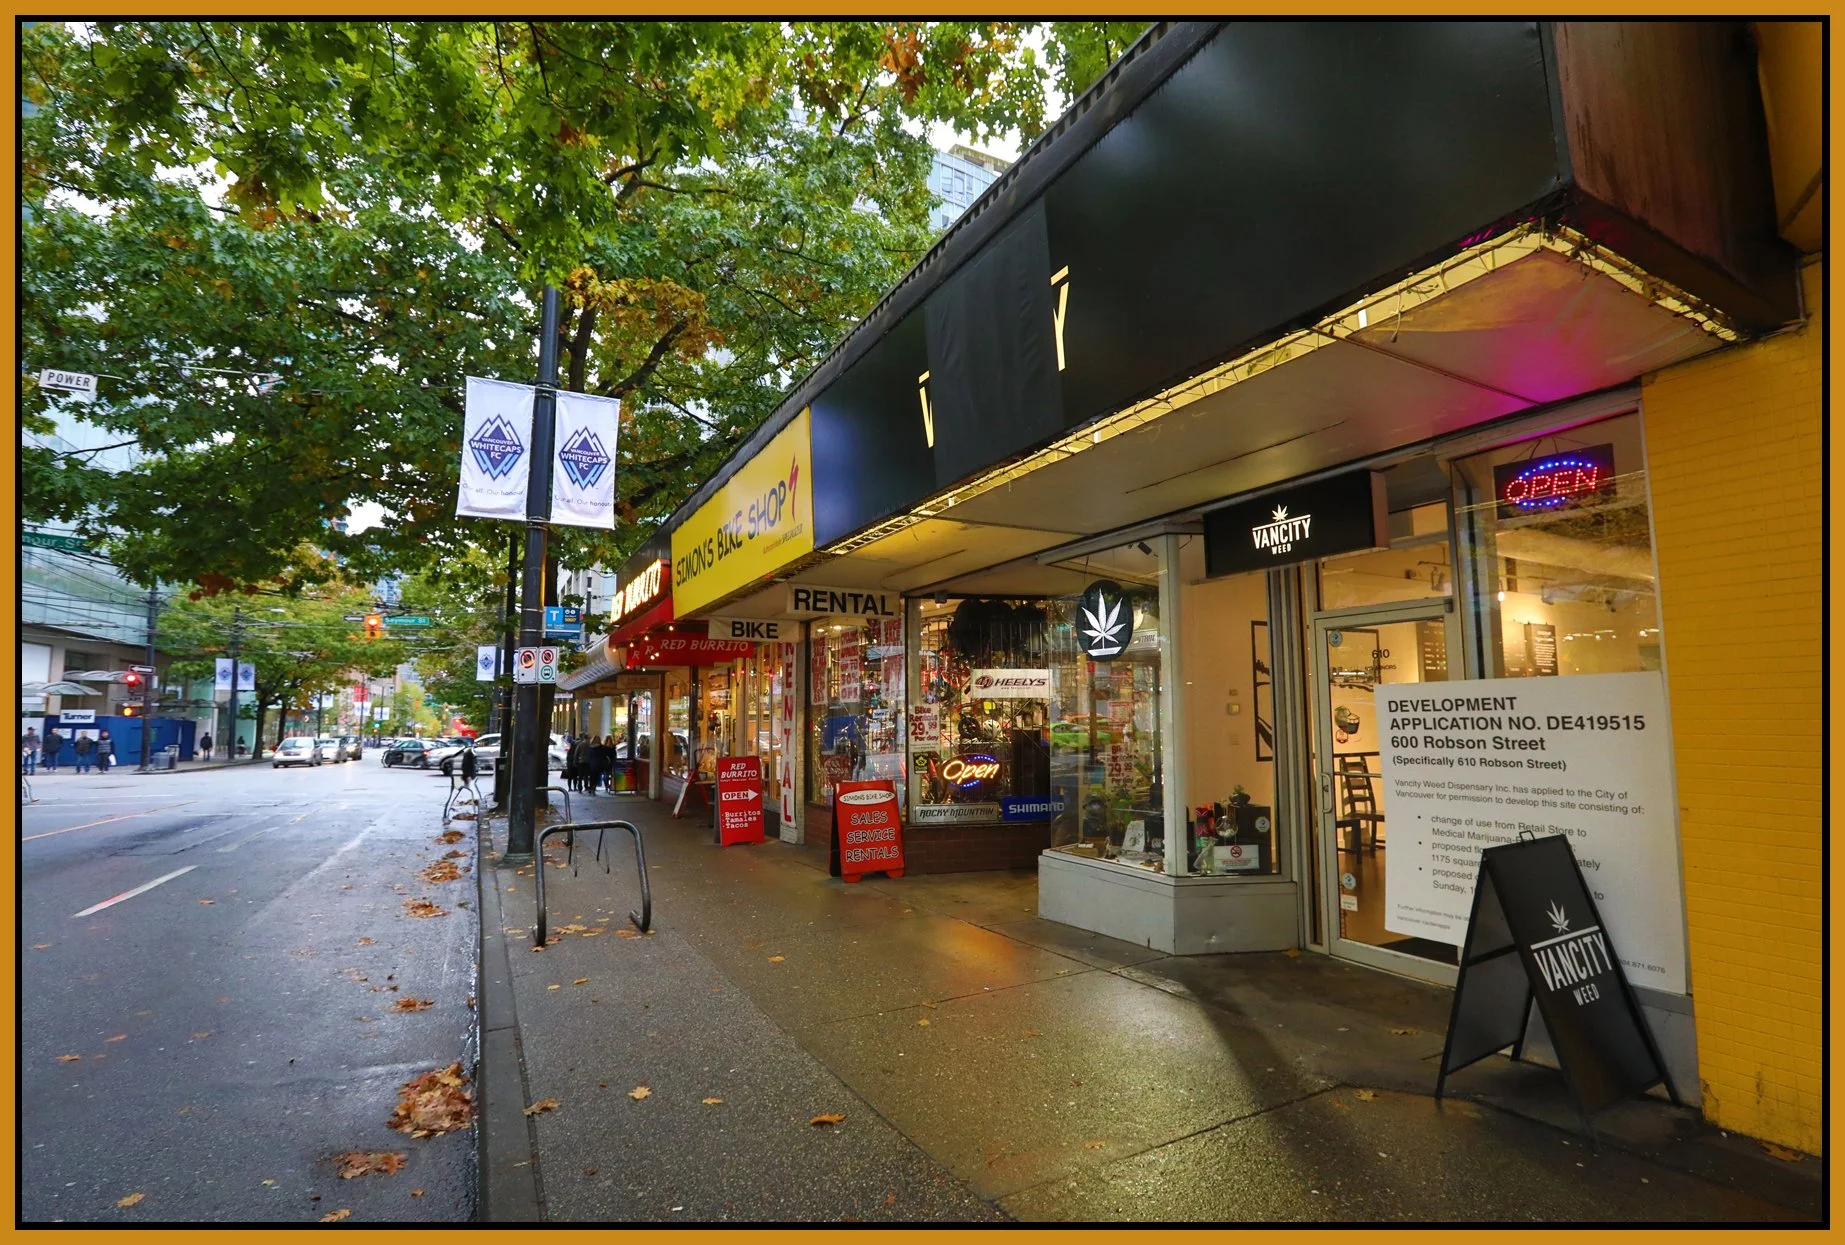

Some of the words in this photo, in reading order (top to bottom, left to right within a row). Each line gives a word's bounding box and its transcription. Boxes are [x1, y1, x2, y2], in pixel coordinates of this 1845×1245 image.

[48, 372, 90, 387] POWER
[471, 440, 521, 453] WHITECAPS
[482, 437, 514, 445] VANCOUVER
[490, 452, 501, 460] FC
[561, 452, 608, 464] WHITECAPS
[578, 462, 589, 470] FC
[1507, 467, 1598, 501] OPEN
[676, 537, 714, 587] SIMON'S
[717, 510, 743, 561] BIKE
[748, 480, 786, 540] SHOP
[1252, 518, 1311, 549] VANCITY
[1272, 543, 1292, 555] WEED
[794, 588, 894, 616] RENTAL
[384, 617, 416, 625] Seymour
[731, 621, 779, 639] BIKE
[660, 639, 686, 650] RED
[690, 639, 748, 652] BURRITO
[1372, 649, 1390, 659] 610
[994, 678, 1048, 686] HEELYS
[915, 706, 931, 714] Bike
[1388, 696, 1517, 713] DEVELOPMENT
[62, 712, 92, 720] Turner
[1390, 717, 1501, 731] APPLICATION
[1508, 717, 1541, 731] NO.
[1547, 715, 1645, 731] DE419515
[1391, 736, 1419, 749] 600
[1424, 736, 1487, 750] Robson
[1493, 736, 1546, 751] Street
[730, 763, 747, 771] RED
[1392, 755, 1454, 768] (Specifically
[1457, 756, 1477, 767] 610
[1480, 757, 1523, 768] Robson
[1526, 758, 1567, 771] Street)
[721, 770, 758, 779] BURRITO
[943, 760, 1000, 785] Open
[724, 791, 749, 800] OPEN
[1395, 779, 1422, 789] Vancity
[1423, 780, 1446, 789] Weed
[1448, 781, 1493, 793] Dispensary
[1496, 784, 1511, 793] Inc.
[1513, 785, 1529, 793] has
[1531, 786, 1564, 797] applied
[1566, 788, 1575, 797] to
[1577, 788, 1592, 797] the
[1595, 789, 1615, 800] City
[1618, 791, 1628, 800] of
[1008, 802, 1065, 814] SHIMANO
[1395, 790, 1434, 799] Vancouver
[1437, 791, 1447, 800] for
[1449, 793, 1493, 804] permission
[1495, 796, 1503, 804] to
[1506, 796, 1539, 807] develop
[1541, 799, 1558, 808] this
[1560, 800, 1576, 809] site
[1578, 802, 1628, 815] consisting
[1631, 805, 1645, 815] of:
[725, 810, 761, 818] Burritos
[725, 815, 757, 823] Tamales
[851, 810, 888, 825] SALES
[919, 809, 949, 819] ROCKY
[950, 807, 994, 819] MOUNTAIN
[1431, 815, 1462, 826] change
[1464, 818, 1473, 826] of
[1476, 819, 1492, 828] use
[1494, 820, 1516, 830] from
[1518, 822, 1546, 833] Retail
[1548, 824, 1574, 836] Store
[1577, 828, 1587, 837] to
[847, 828, 895, 844] SERVICE
[1432, 827, 1465, 839] Medical
[1431, 841, 1472, 853] proposed
[846, 846, 899, 862] RENTALS
[1431, 854, 1451, 864] 1175
[1432, 868, 1473, 880] proposed
[1594, 890, 1605, 900] to
[1534, 933, 1612, 991] VANCITY
[1573, 983, 1600, 1007] WEED
